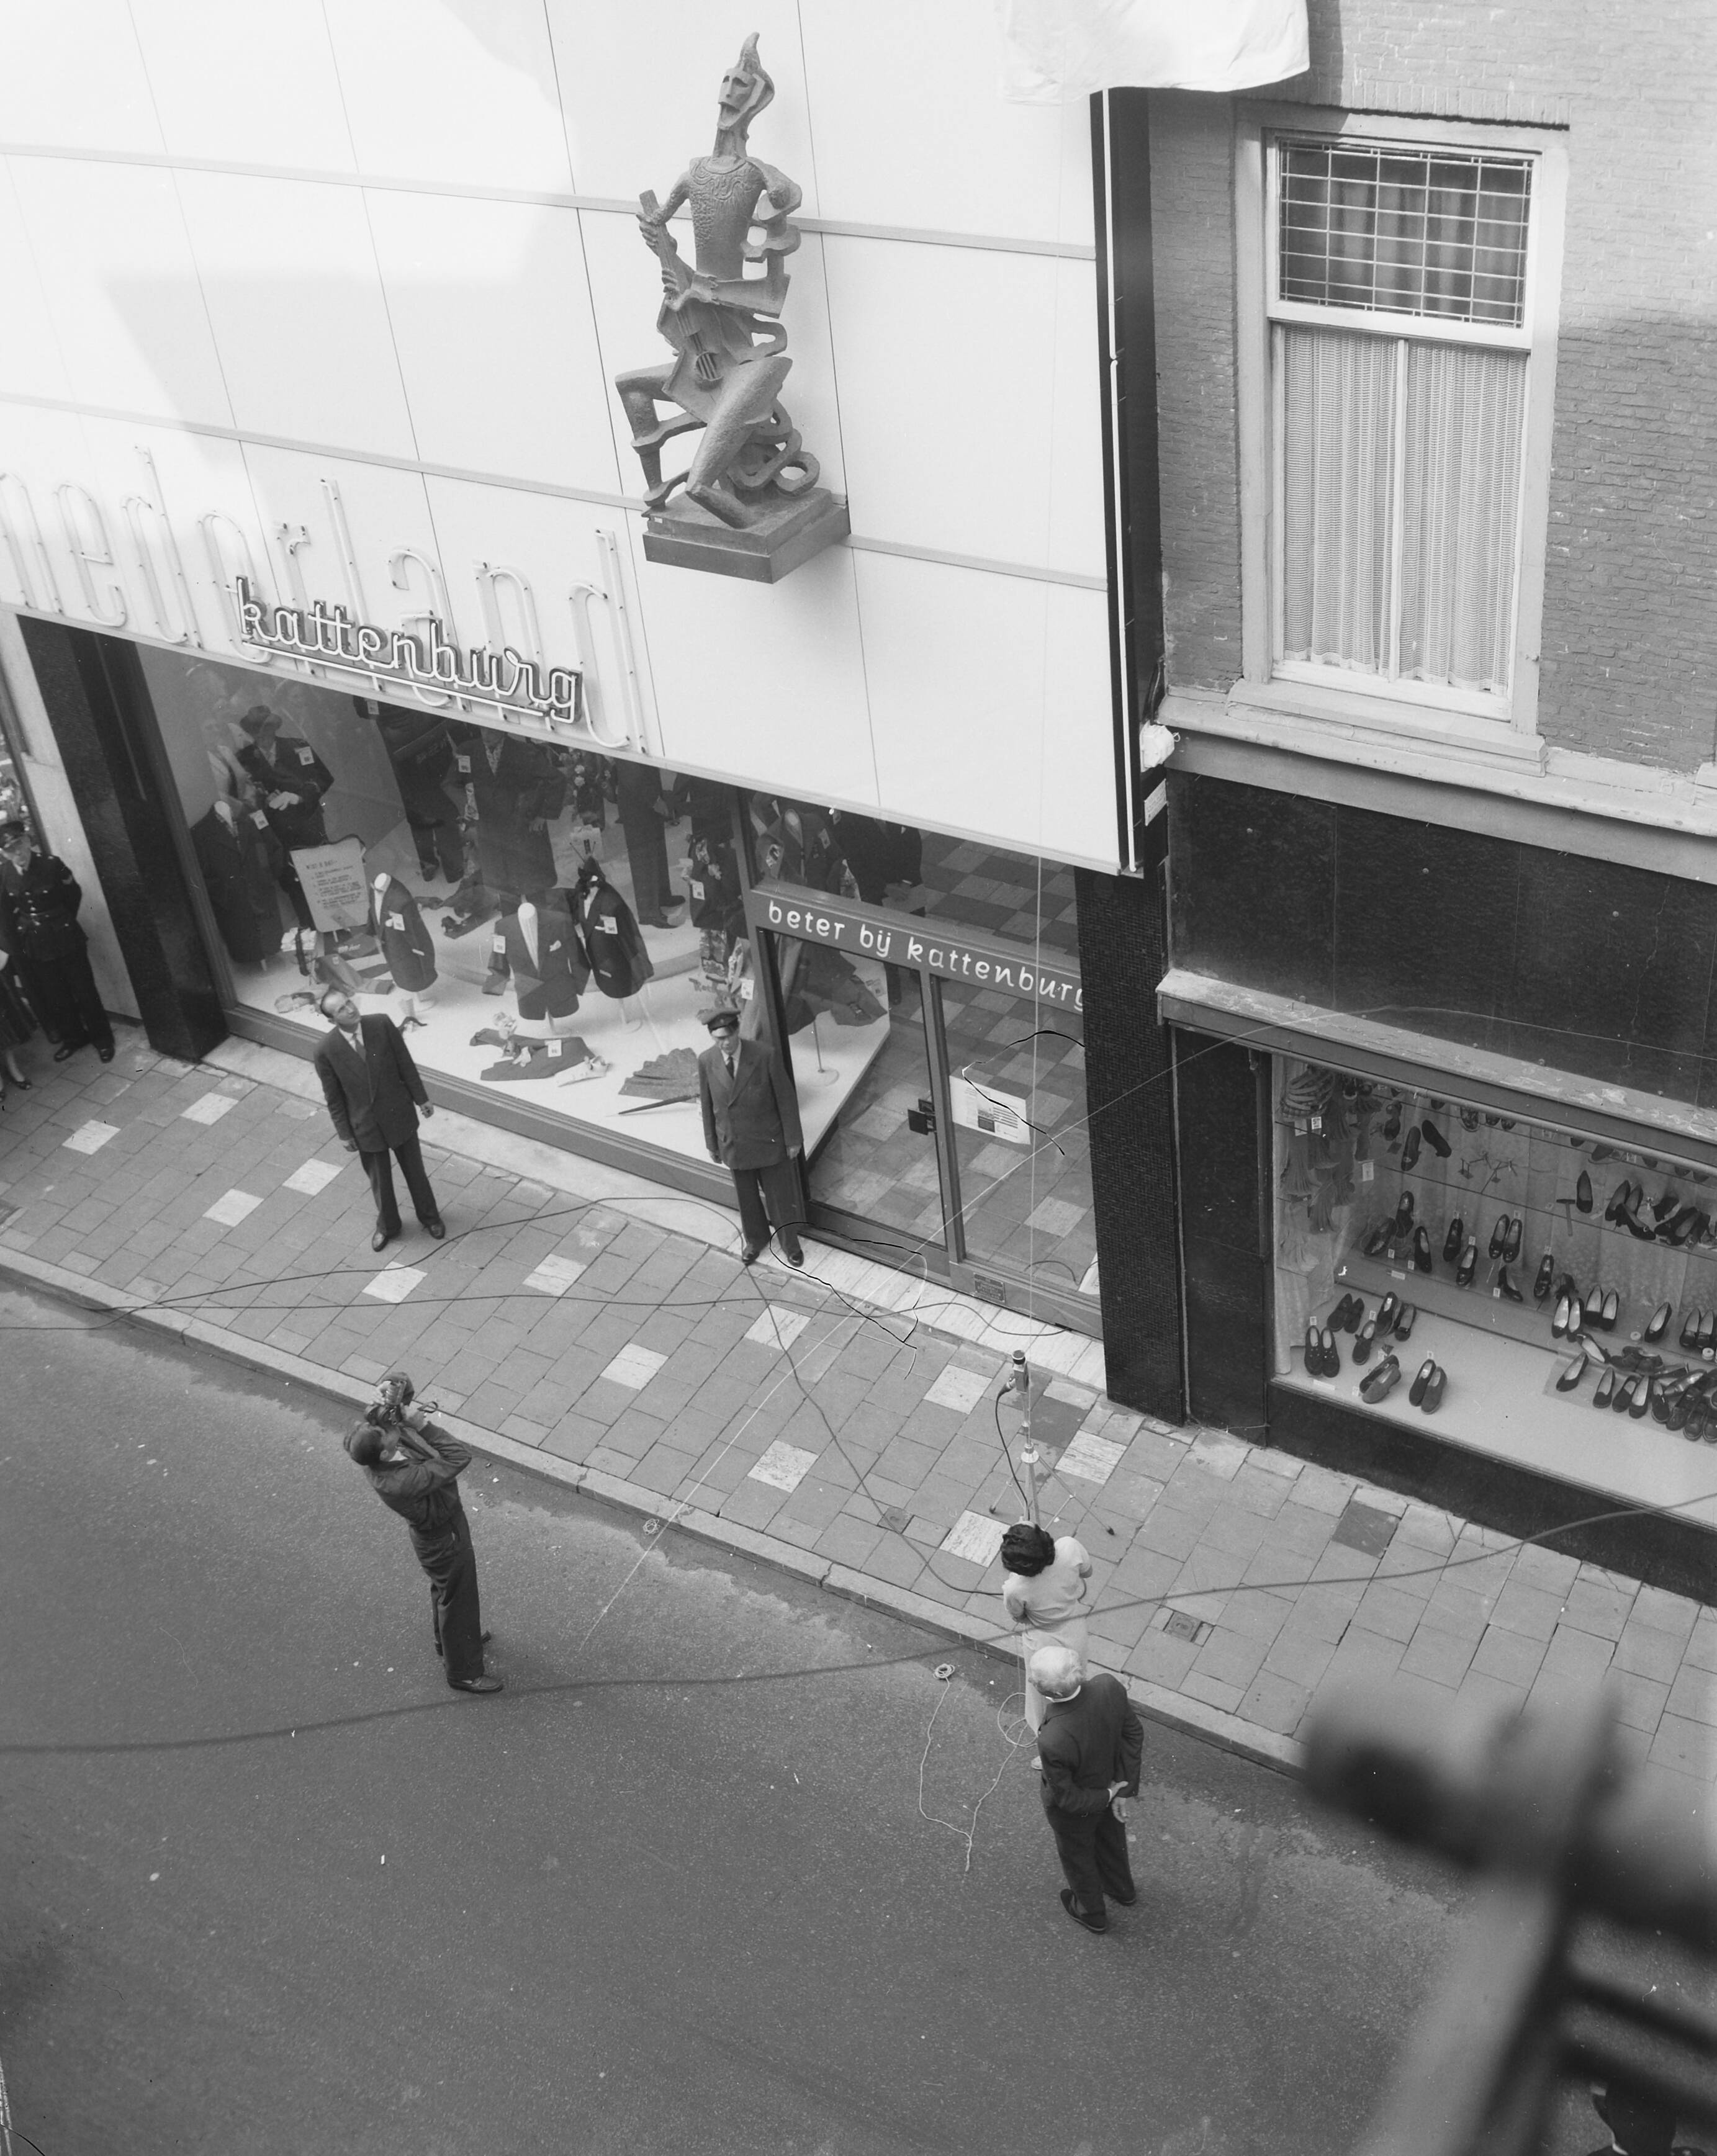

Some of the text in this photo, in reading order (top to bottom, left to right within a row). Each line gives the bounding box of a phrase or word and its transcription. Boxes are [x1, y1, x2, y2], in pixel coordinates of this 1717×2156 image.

[236, 575, 584, 724] kattenburg
[768, 899, 845, 940] beter
[859, 923, 892, 958] bij
